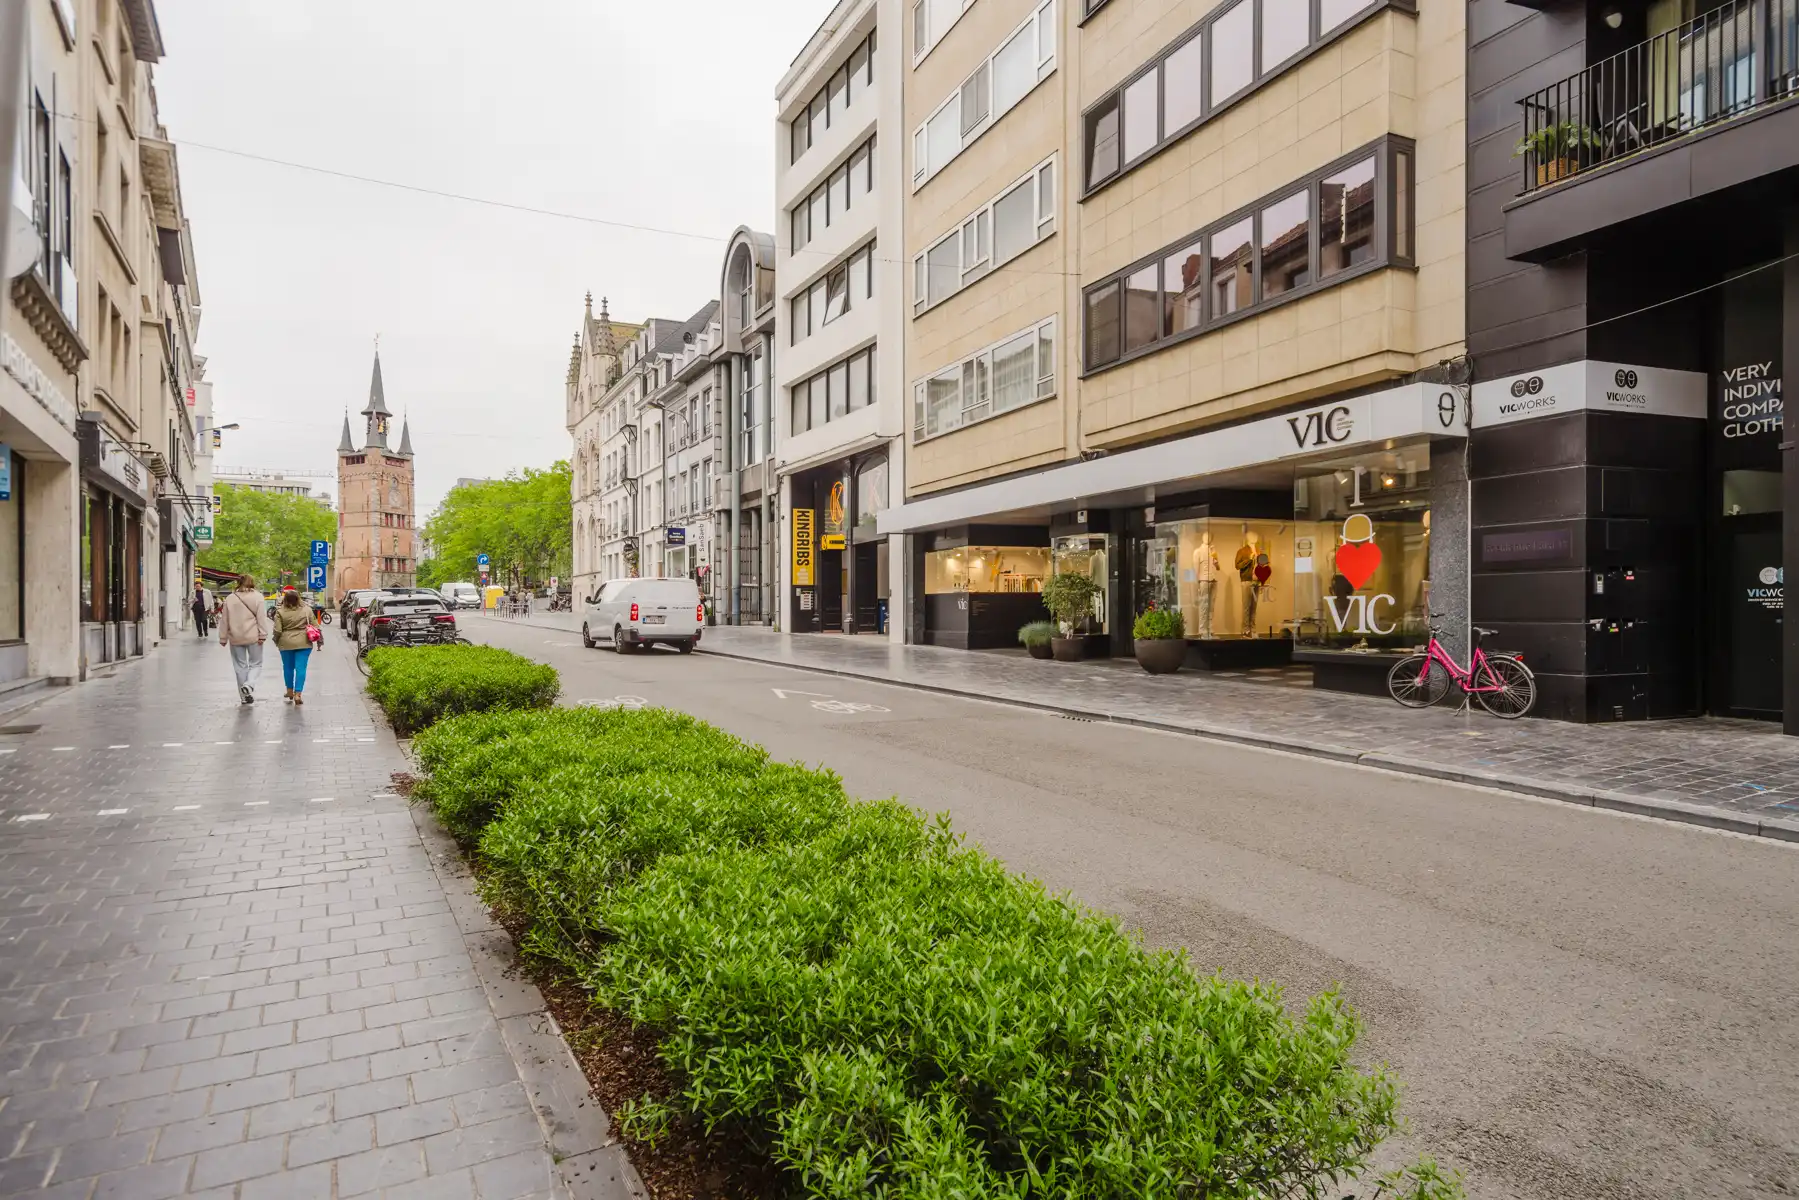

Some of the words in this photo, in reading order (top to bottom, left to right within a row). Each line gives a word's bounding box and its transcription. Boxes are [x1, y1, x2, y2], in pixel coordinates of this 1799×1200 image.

[1722, 361, 1772, 383] VERY
[1606, 391, 1646, 404] VICWORKS
[1724, 378, 1781, 402] INDIVI
[1499, 395, 1556, 414] VICWORKS
[1286, 406, 1351, 448] VIC
[1723, 417, 1783, 438] CLOTH
[1350, 466, 1366, 507] I
[315, 542, 324, 553] P
[796, 510, 810, 566] KINGRIBS
[310, 566, 324, 584] P
[1323, 593, 1397, 635] VIC
